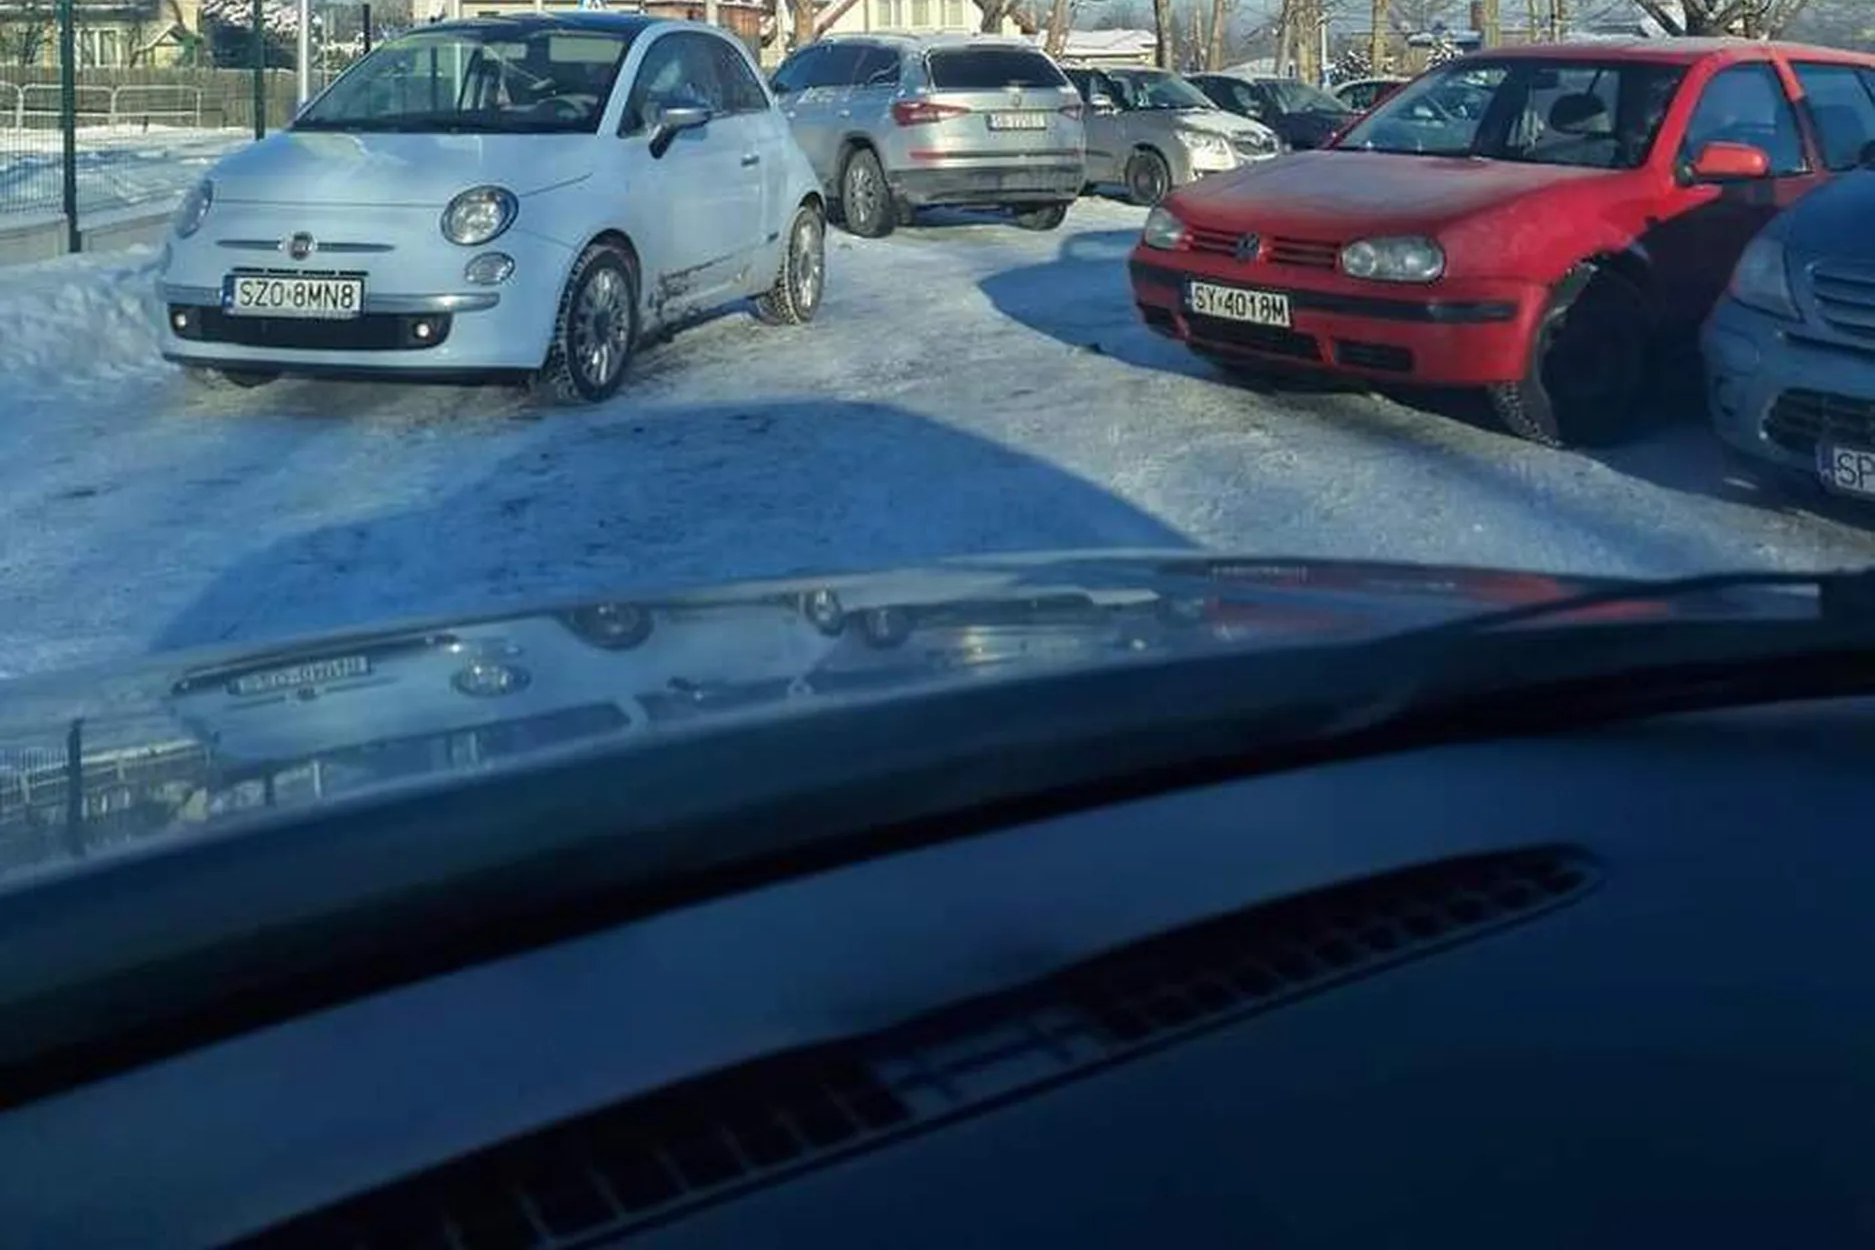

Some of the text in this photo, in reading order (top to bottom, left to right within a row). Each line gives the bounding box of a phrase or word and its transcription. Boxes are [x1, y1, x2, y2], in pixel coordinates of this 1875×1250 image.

[293, 282, 355, 310] 8MN8
[1195, 286, 1217, 311] SY
[1837, 452, 1875, 489] SP
